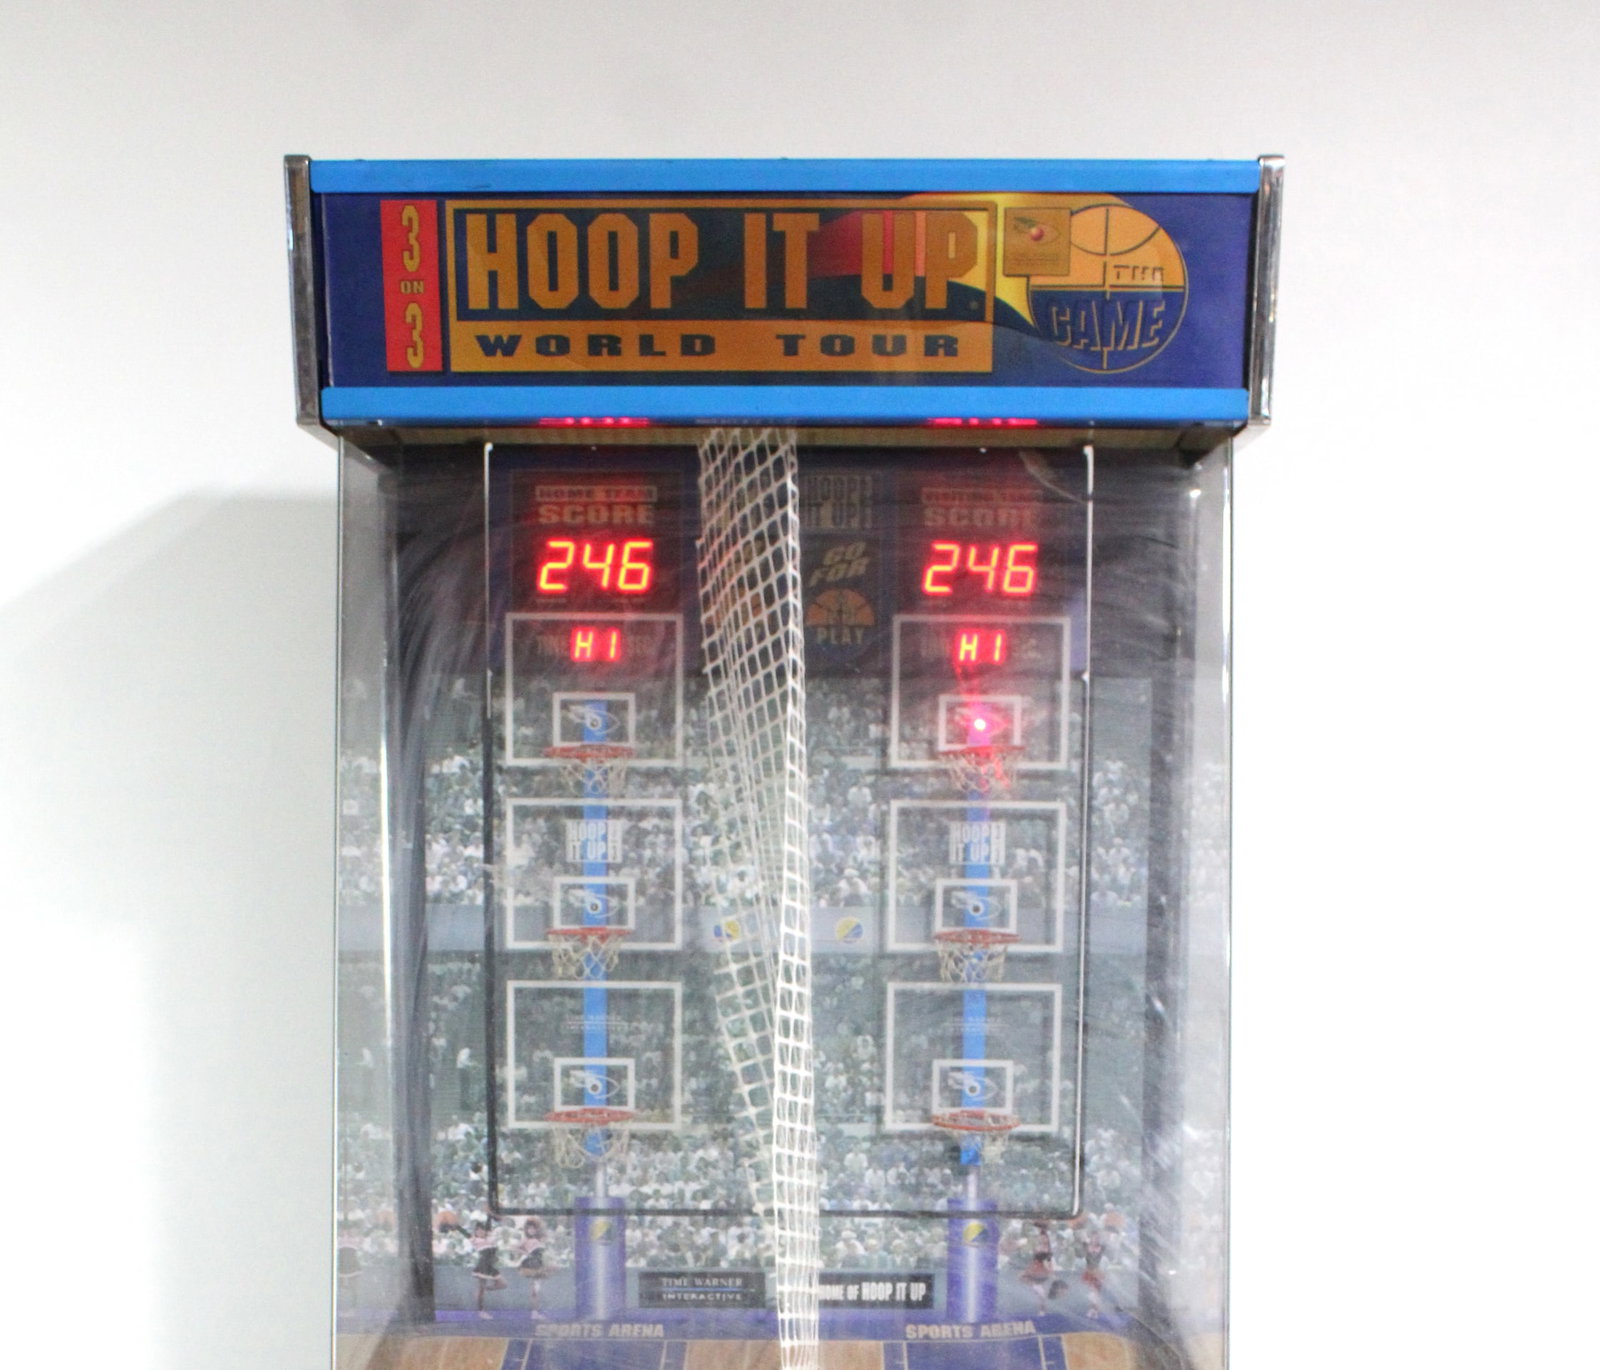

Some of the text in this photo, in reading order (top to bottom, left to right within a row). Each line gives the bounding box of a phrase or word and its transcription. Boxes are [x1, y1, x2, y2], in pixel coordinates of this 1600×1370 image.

[466, 212, 978, 310] HOOP IT UP
[400, 205, 424, 368] 3 ON 3
[1052, 300, 1166, 350] GAME
[475, 334, 958, 357] WORLD TOUR
[539, 505, 655, 526] SCORE
[538, 539, 654, 591] 246
[923, 542, 1037, 594] 246
[662, 1277, 743, 1286] TIME WARNER
[846, 1285, 859, 1300] OF
[862, 1282, 893, 1301] HOOP
[896, 1282, 907, 1301] IT
[910, 1282, 926, 1301] UP
[535, 1323, 665, 1338] SPORTS ARENA
[905, 1320, 1037, 1339] SPORTS ARENA
